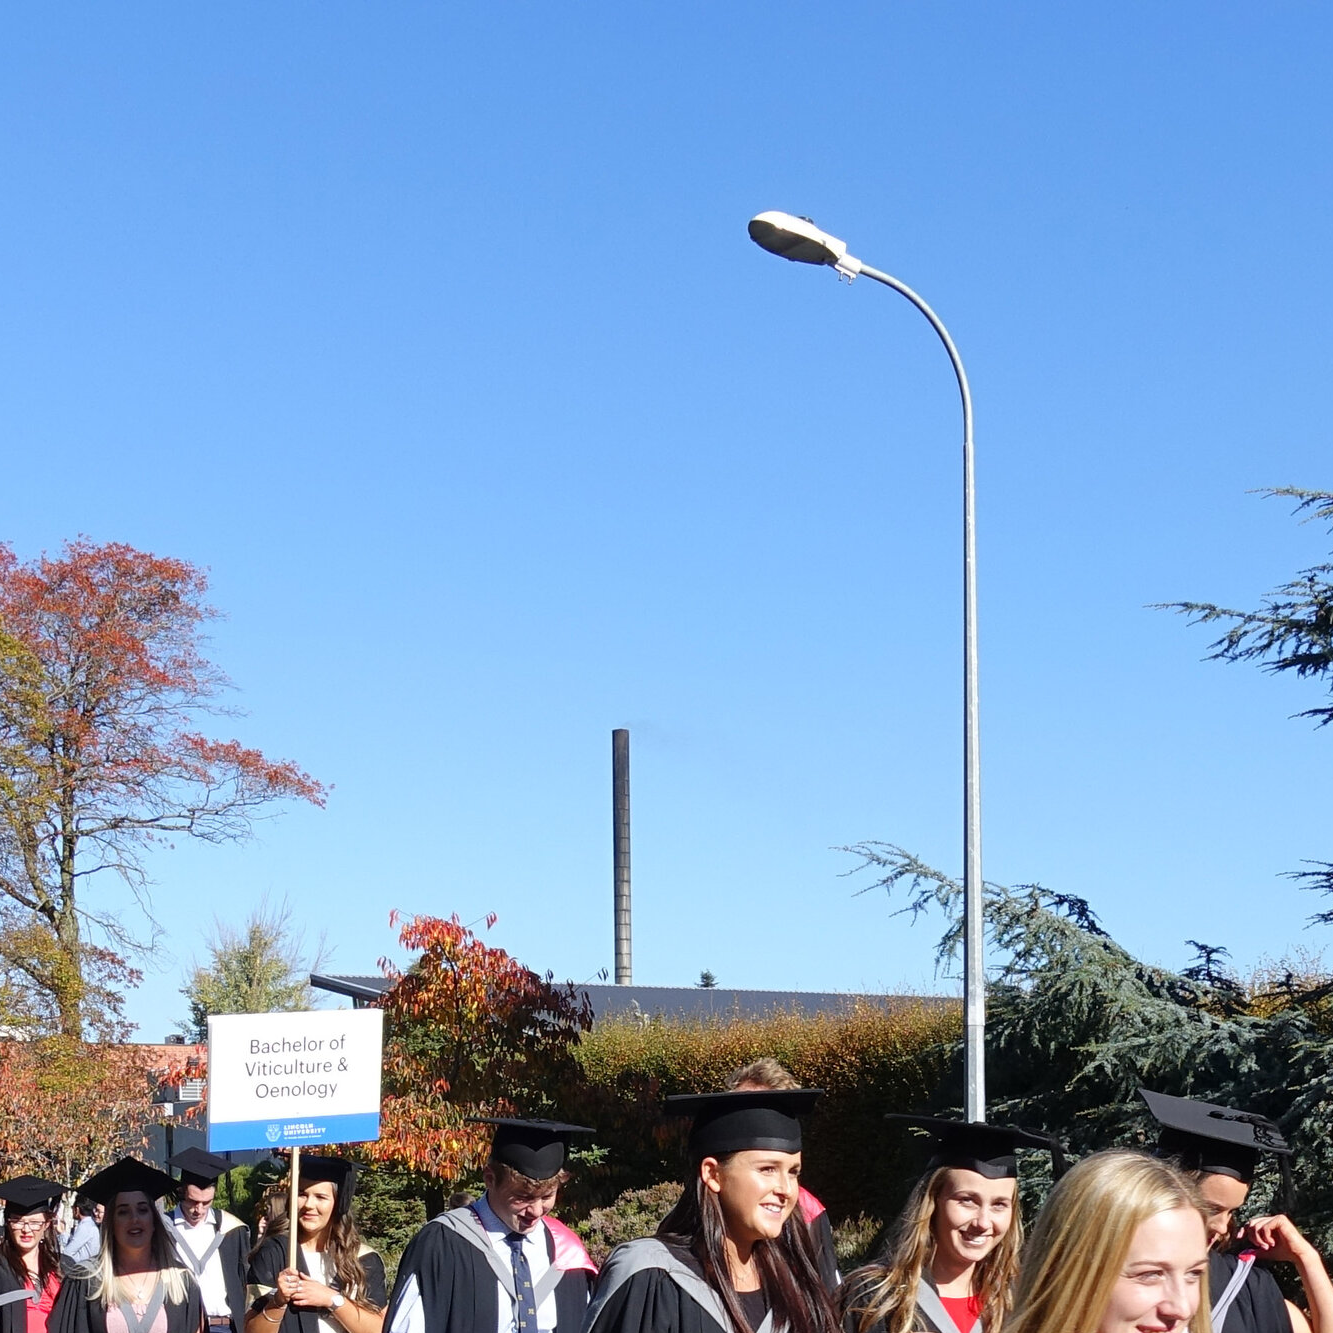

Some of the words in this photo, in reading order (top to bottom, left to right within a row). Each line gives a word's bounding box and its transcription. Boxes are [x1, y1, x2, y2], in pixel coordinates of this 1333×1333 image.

[250, 1036, 324, 1054] Bachelor
[329, 1034, 346, 1050] of
[245, 1059, 332, 1077] Viticulture
[337, 1057, 348, 1072] &
[255, 1081, 338, 1099] Oenology
[283, 1127, 326, 1136] UNIVERSITY
